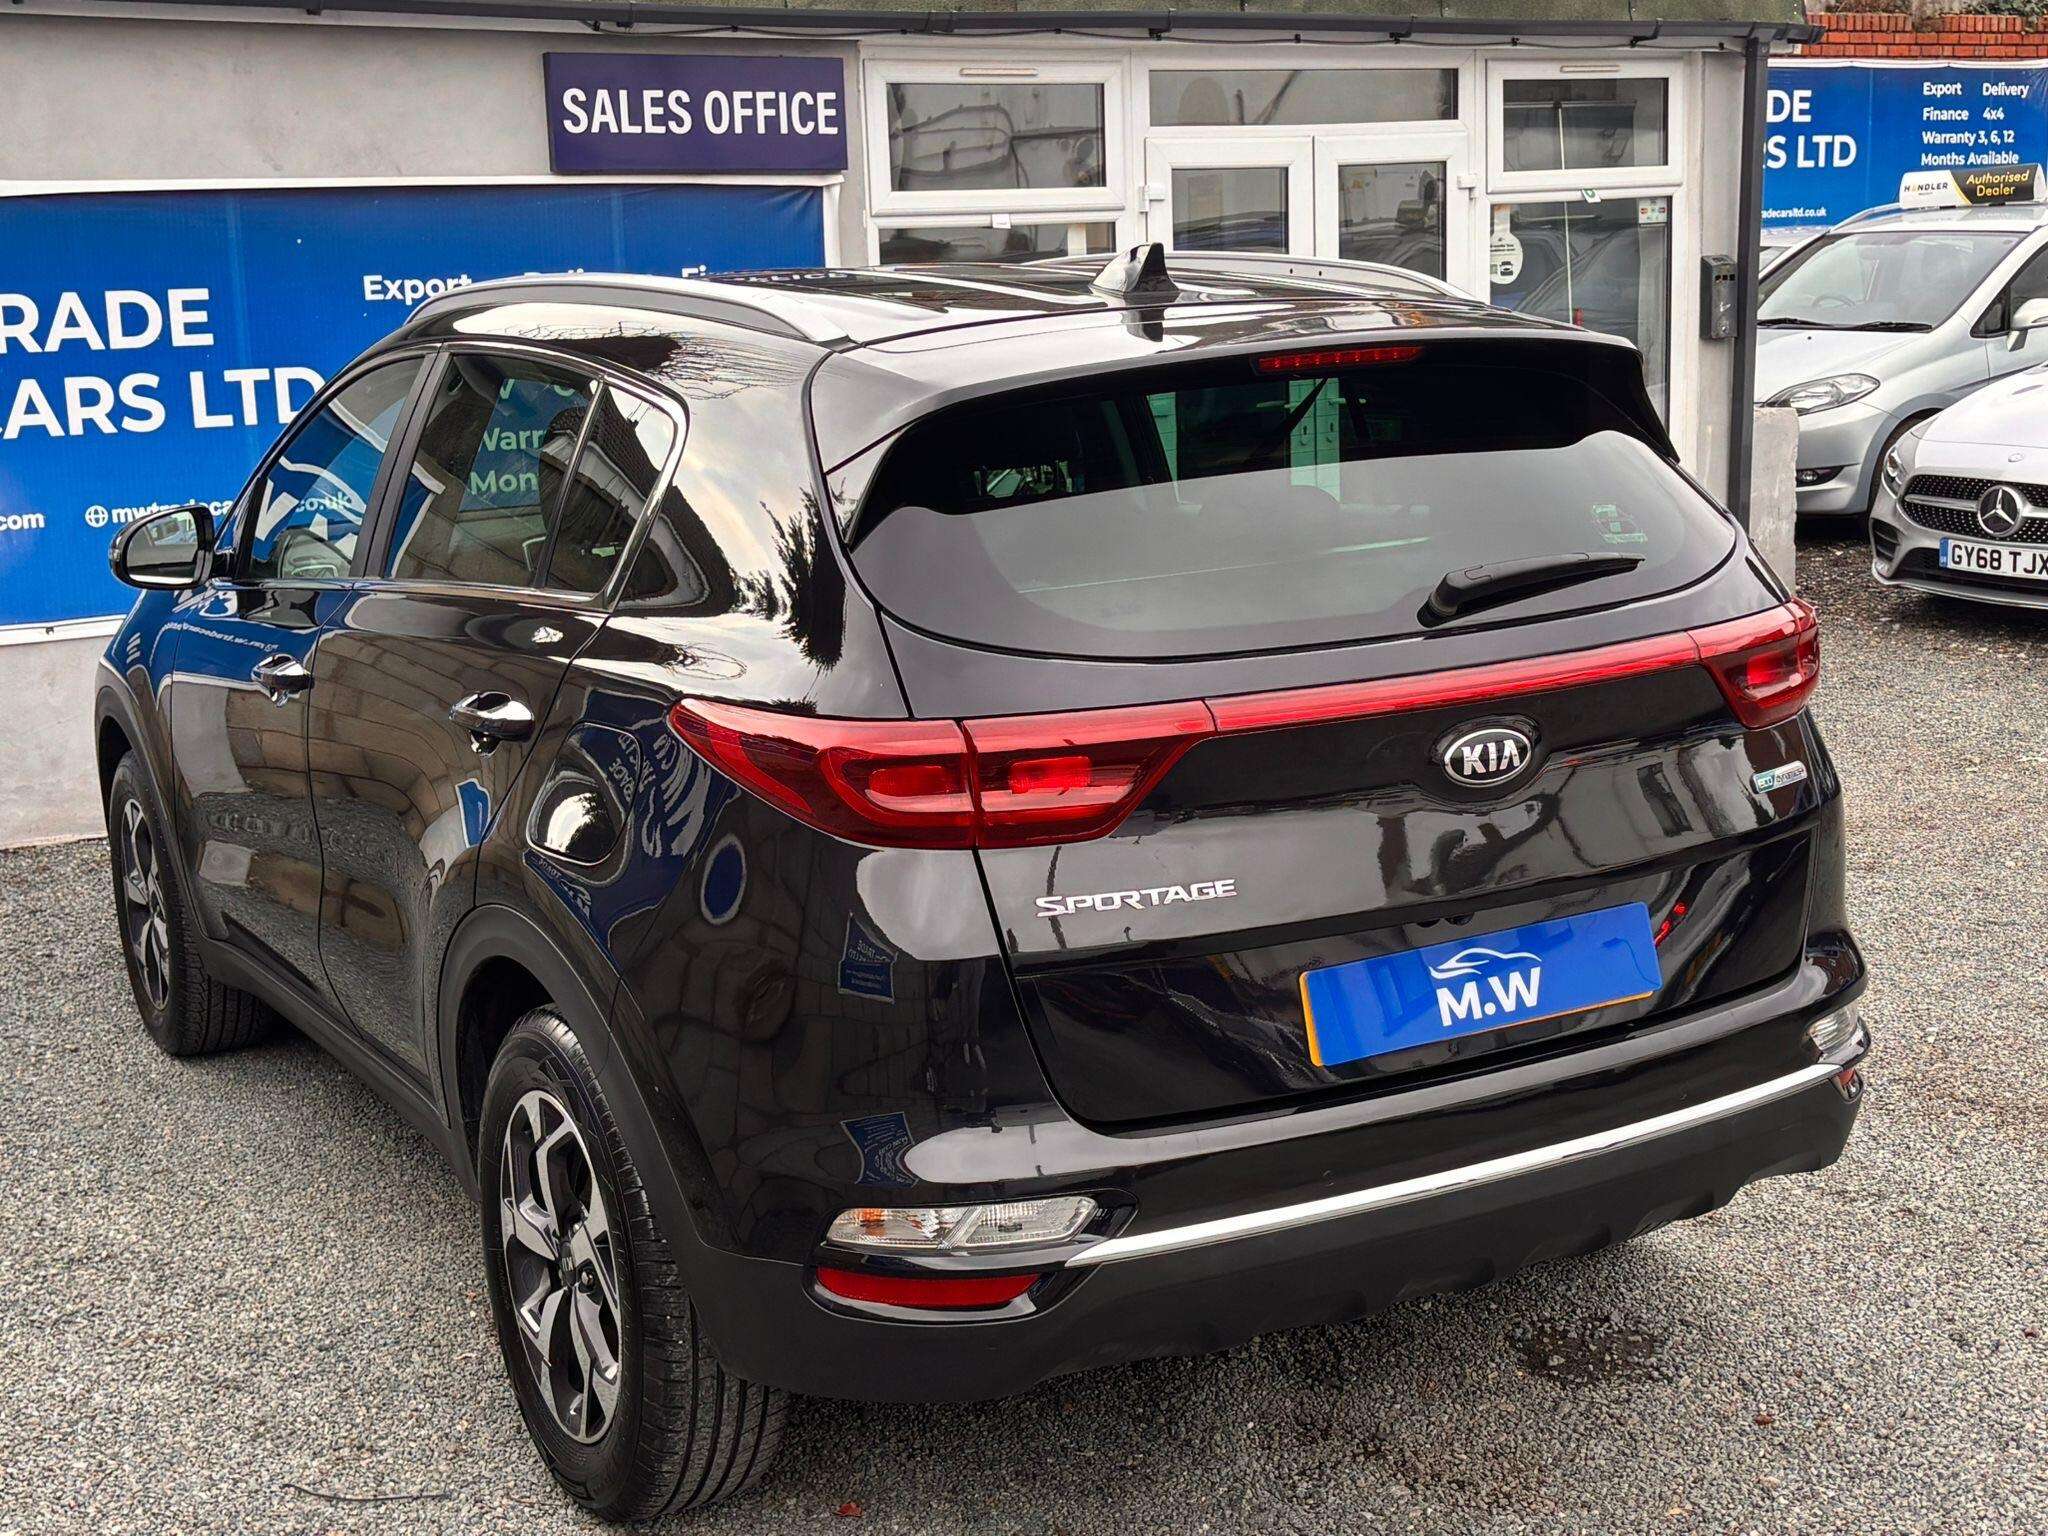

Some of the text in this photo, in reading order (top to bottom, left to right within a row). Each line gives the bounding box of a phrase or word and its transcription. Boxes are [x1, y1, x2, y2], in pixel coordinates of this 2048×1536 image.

[1923, 82, 2030, 98] Export Delivery
[562, 88, 839, 135] SALES OFFICE
[1922, 106, 2005, 120] Finance 4x4
[1763, 135, 1857, 169] S LTD
[1922, 130, 2015, 147] Warranty 3, 6, 12
[1921, 151, 2019, 166] Months Available
[1966, 170, 2030, 185] Authorised
[1976, 185, 2016, 197] Dealer
[0, 366, 326, 440] ARS LTD
[1951, 544, 2002, 571] GY68
[2009, 551, 2048, 575] TJX
[1462, 740, 1521, 775] KIA
[1035, 879, 1238, 917] SPORTAGE
[1436, 967, 1541, 1027] M.W
